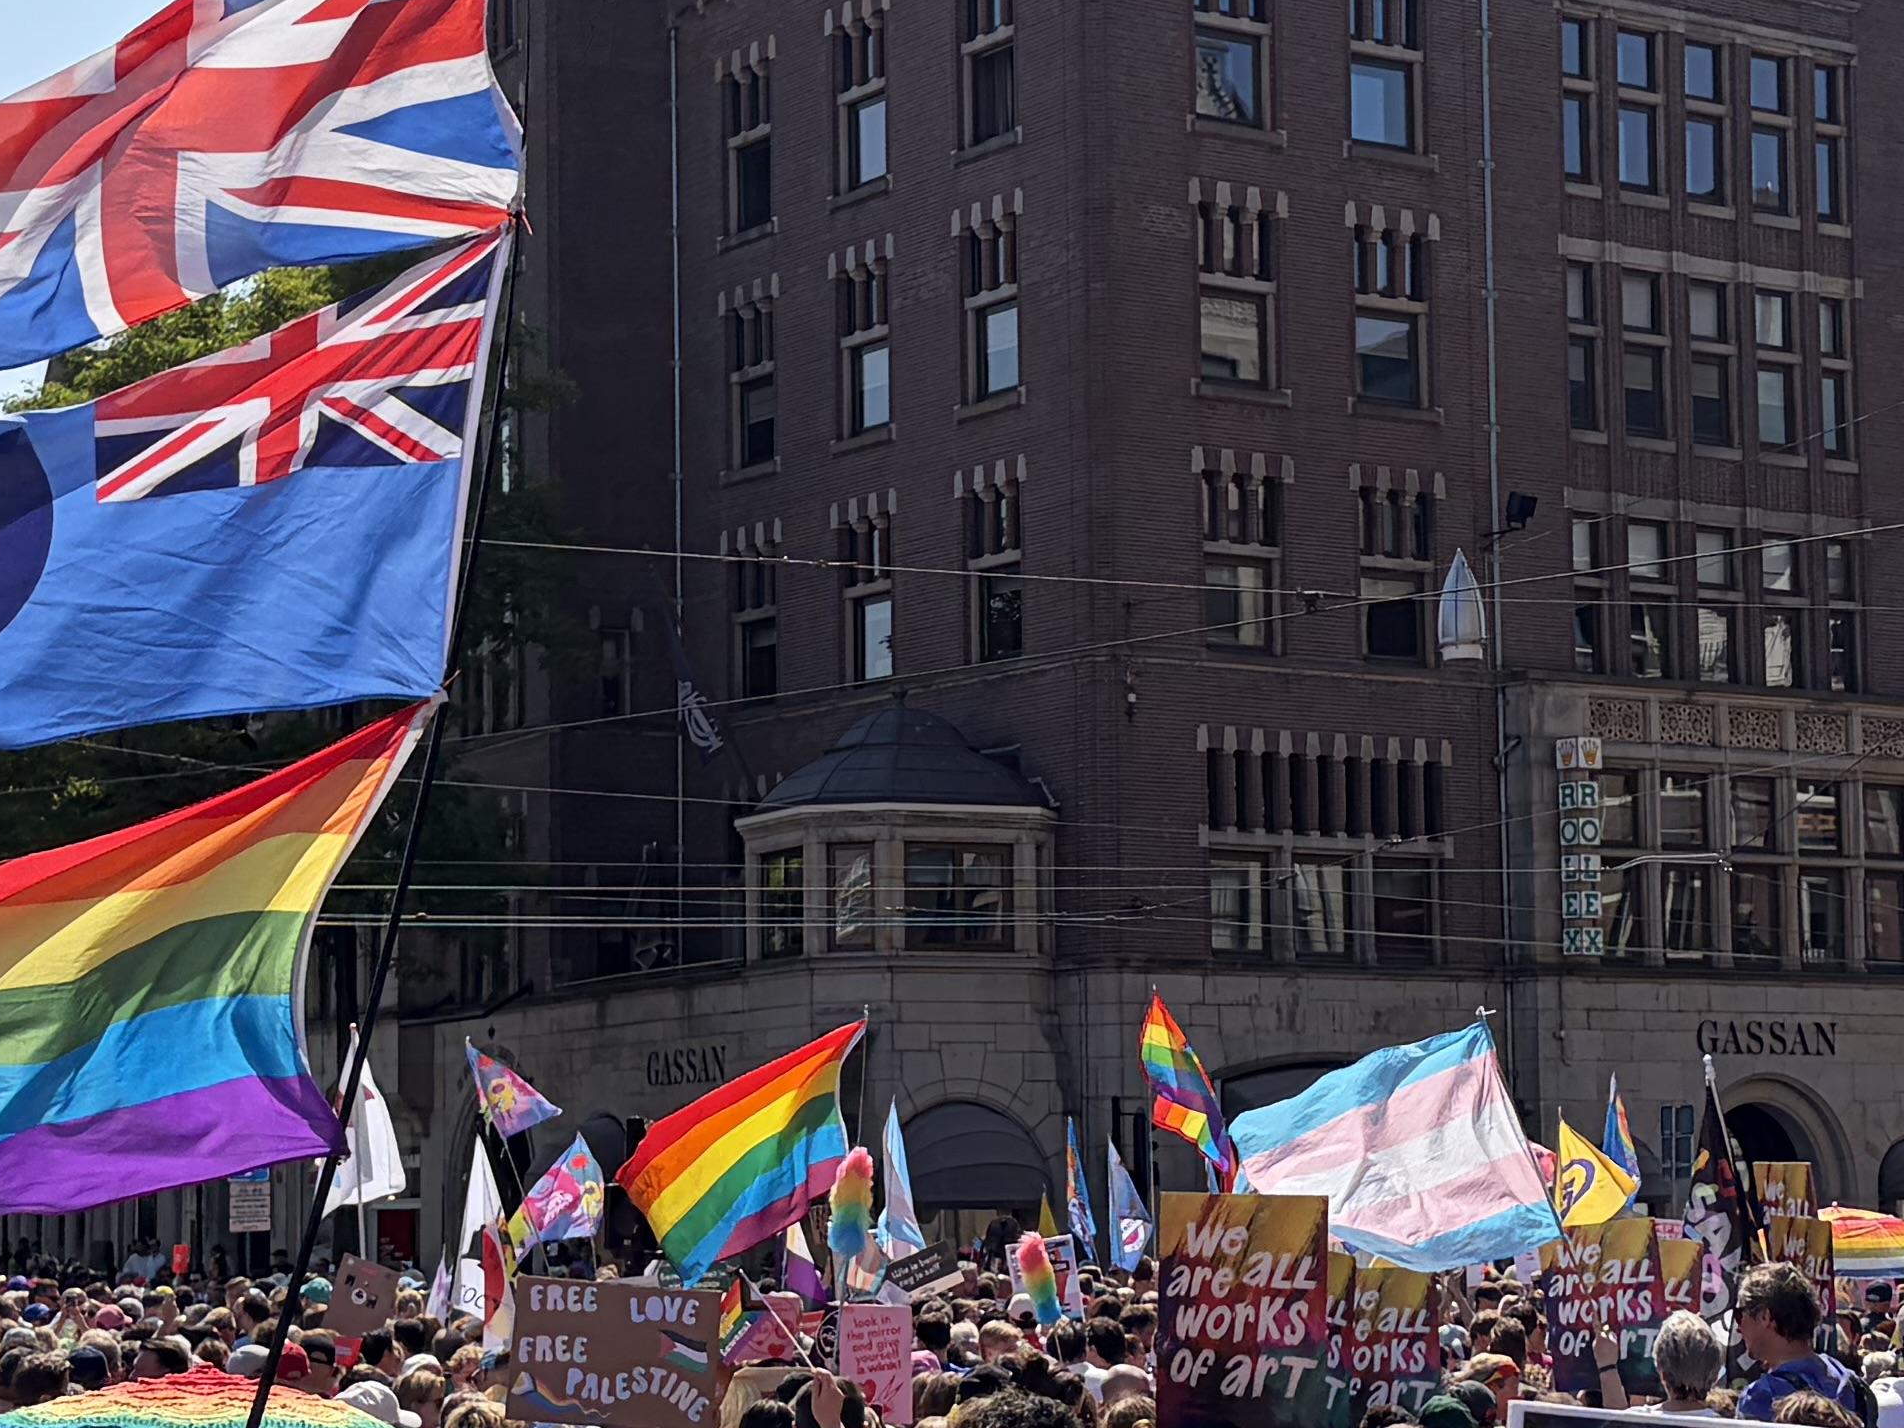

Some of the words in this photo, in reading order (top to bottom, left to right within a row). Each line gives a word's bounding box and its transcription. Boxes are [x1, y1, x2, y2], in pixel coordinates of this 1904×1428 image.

[1696, 1019, 1837, 1057] GASSAN
[646, 1045, 727, 1086] GASSAN
[1186, 1220, 1249, 1258] We
[1166, 1264, 1236, 1299] are
[529, 1284, 598, 1313] FREE
[629, 1295, 700, 1325] LOVE
[853, 1317, 880, 1328] look
[881, 1316, 892, 1326] in
[518, 1335, 587, 1364] FREE
[847, 1330, 865, 1341] the
[866, 1325, 901, 1339] mirror
[852, 1340, 874, 1353] and
[565, 1366, 710, 1423] PALESTINE
